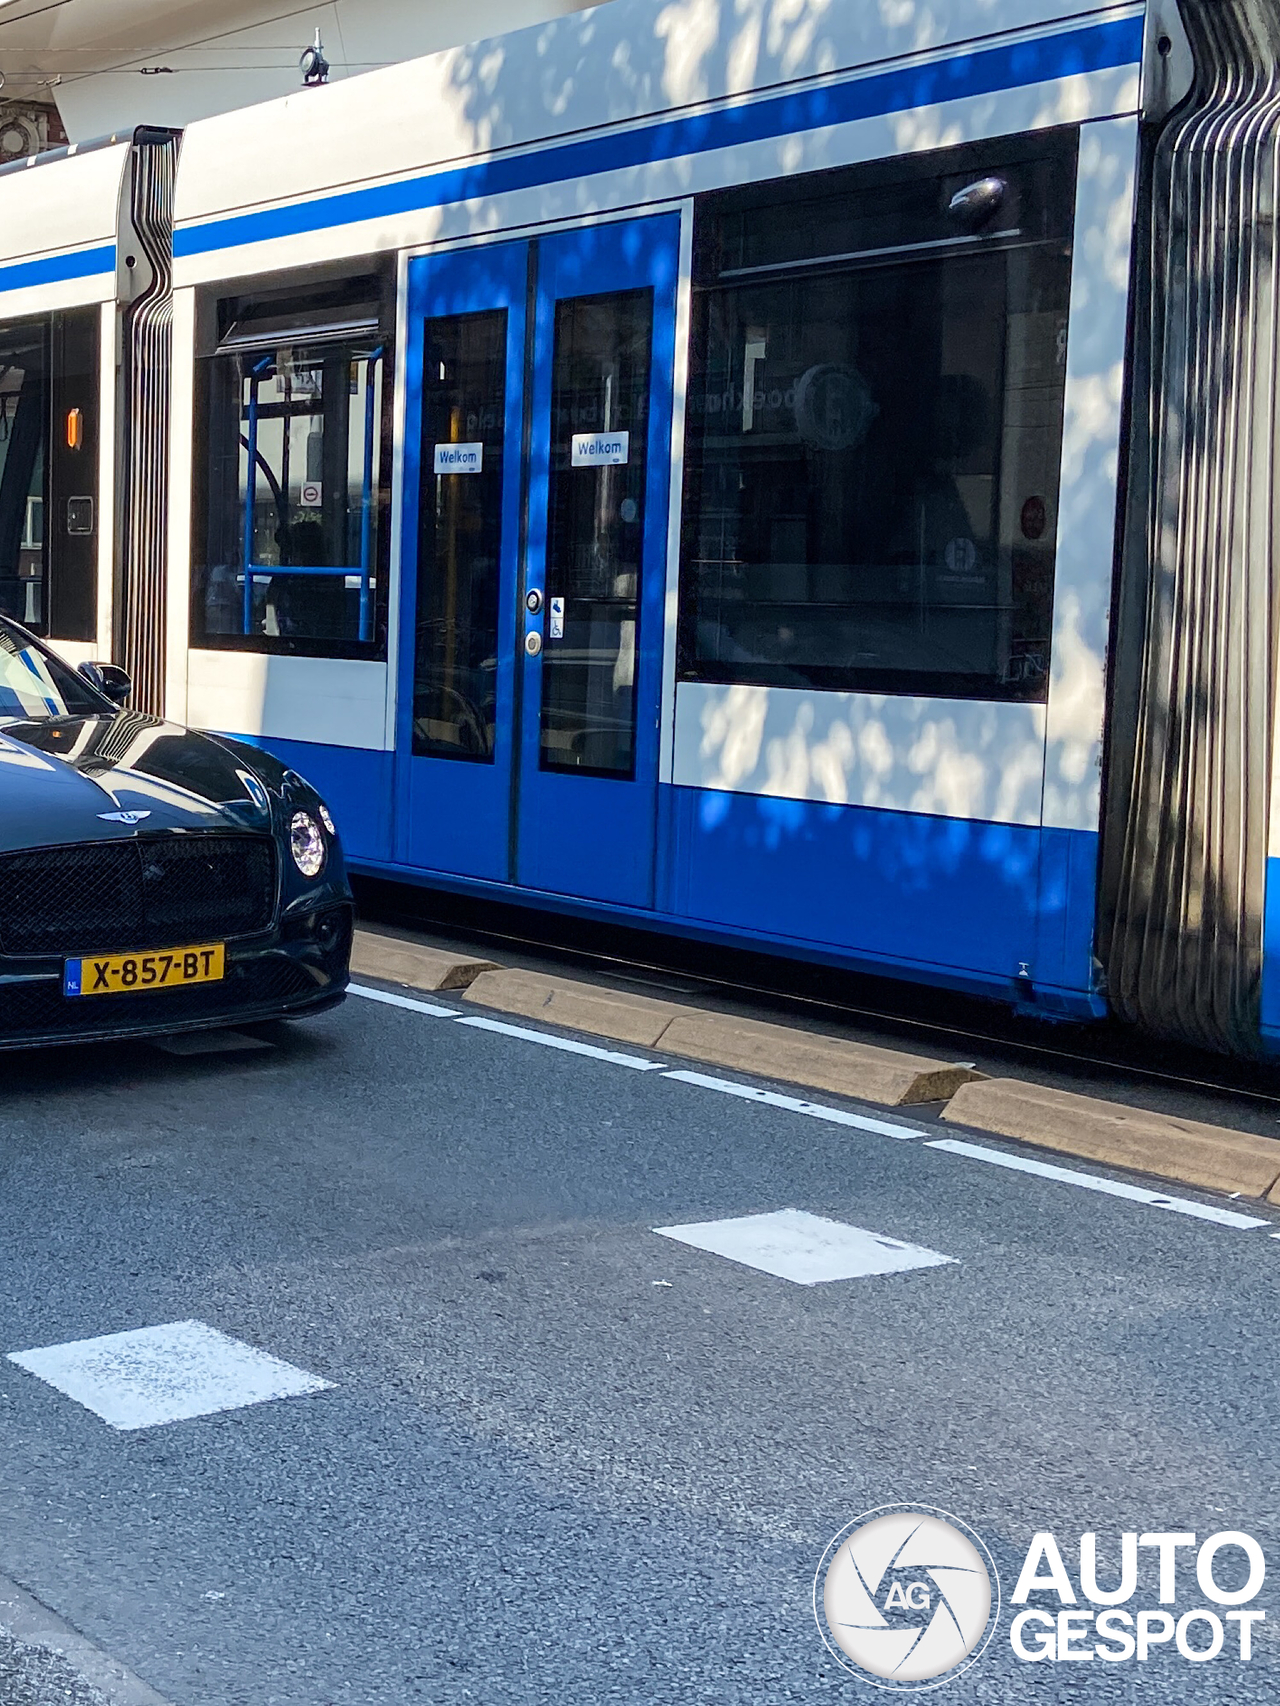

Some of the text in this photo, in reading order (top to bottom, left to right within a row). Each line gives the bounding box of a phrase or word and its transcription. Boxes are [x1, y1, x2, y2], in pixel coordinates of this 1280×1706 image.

[579, 440, 621, 455] Welkom
[440, 450, 476, 463] Welkom
[93, 950, 215, 990] X-857-BT
[67, 981, 79, 989] NL
